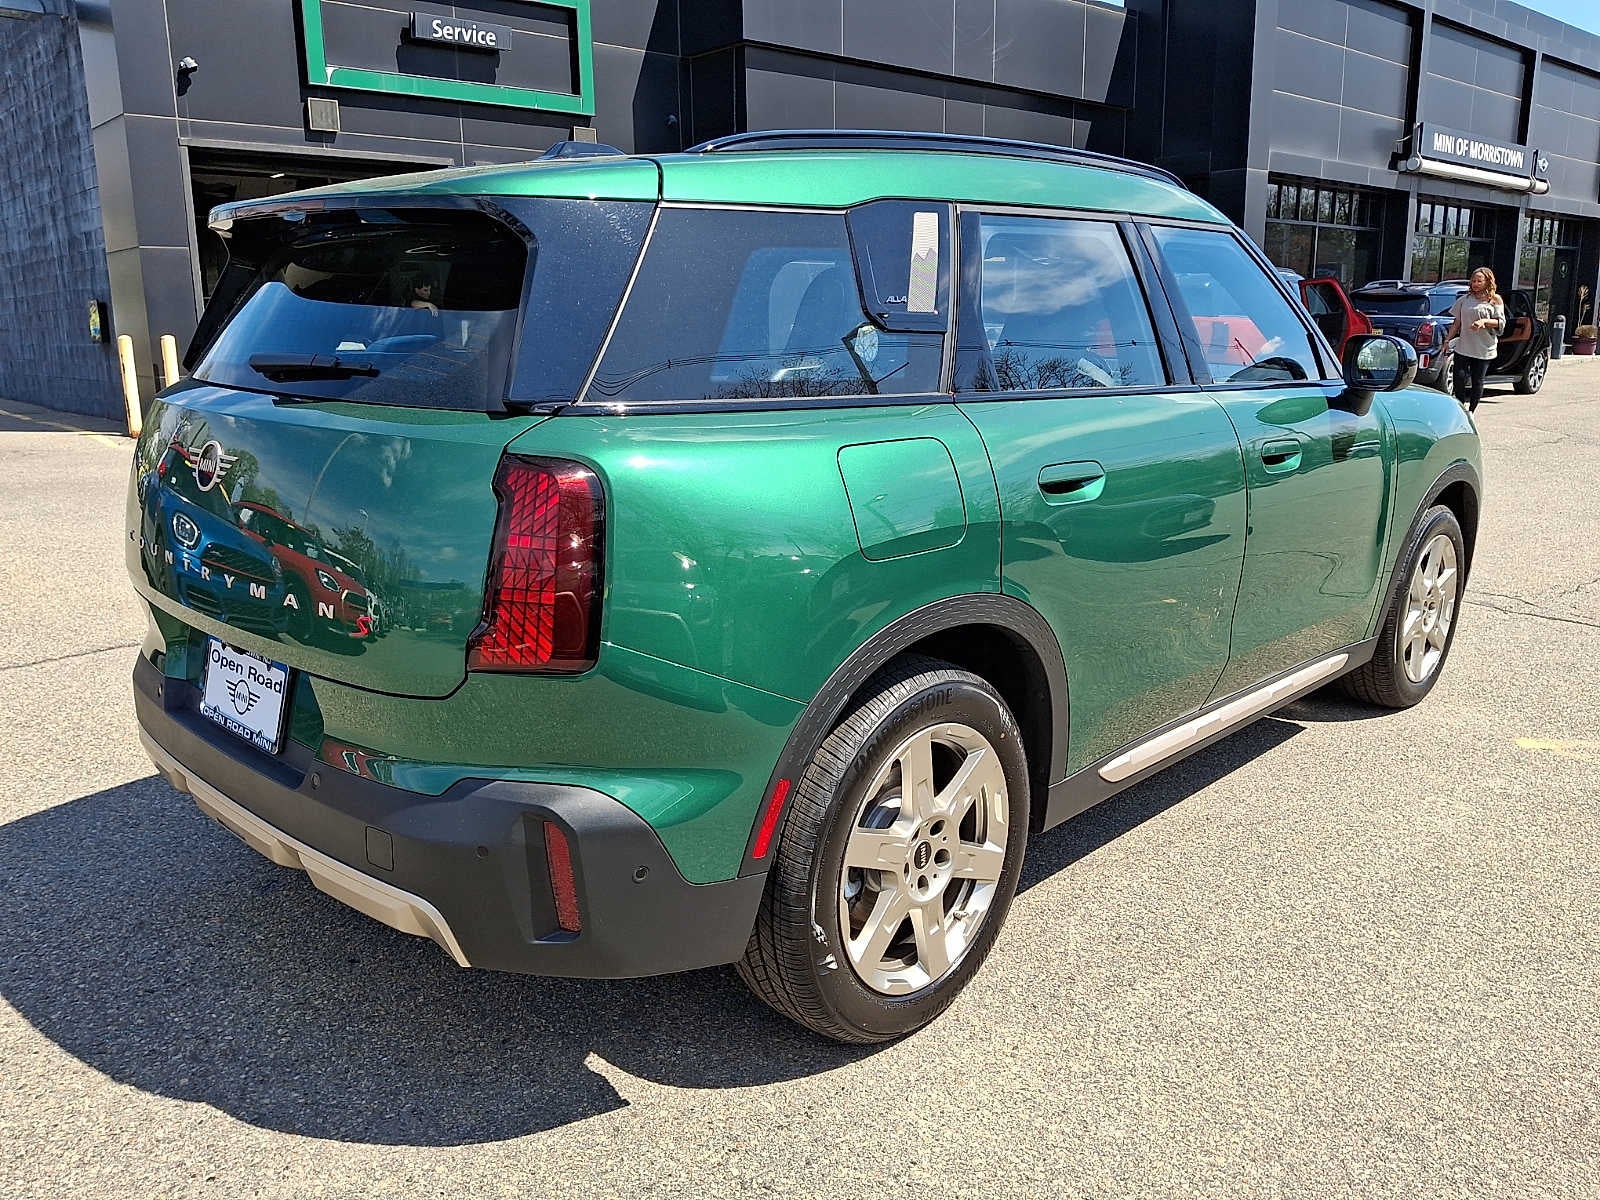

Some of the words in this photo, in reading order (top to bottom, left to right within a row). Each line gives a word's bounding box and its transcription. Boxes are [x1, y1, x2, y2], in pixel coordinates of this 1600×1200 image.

[432, 19, 497, 46] Service
[1433, 132, 1455, 154] MINI
[1456, 138, 1469, 157] OF
[1469, 140, 1525, 169] MORRISTOWN
[199, 457, 217, 473] MINI
[129, 529, 335, 619] COUNTRYMAN
[211, 649, 244, 675] Open
[247, 666, 282, 695] Road
[236, 690, 248, 704] MINI
[203, 706, 226, 725] OPEN
[226, 720, 251, 739] ROAD
[252, 734, 273, 752] MINI
